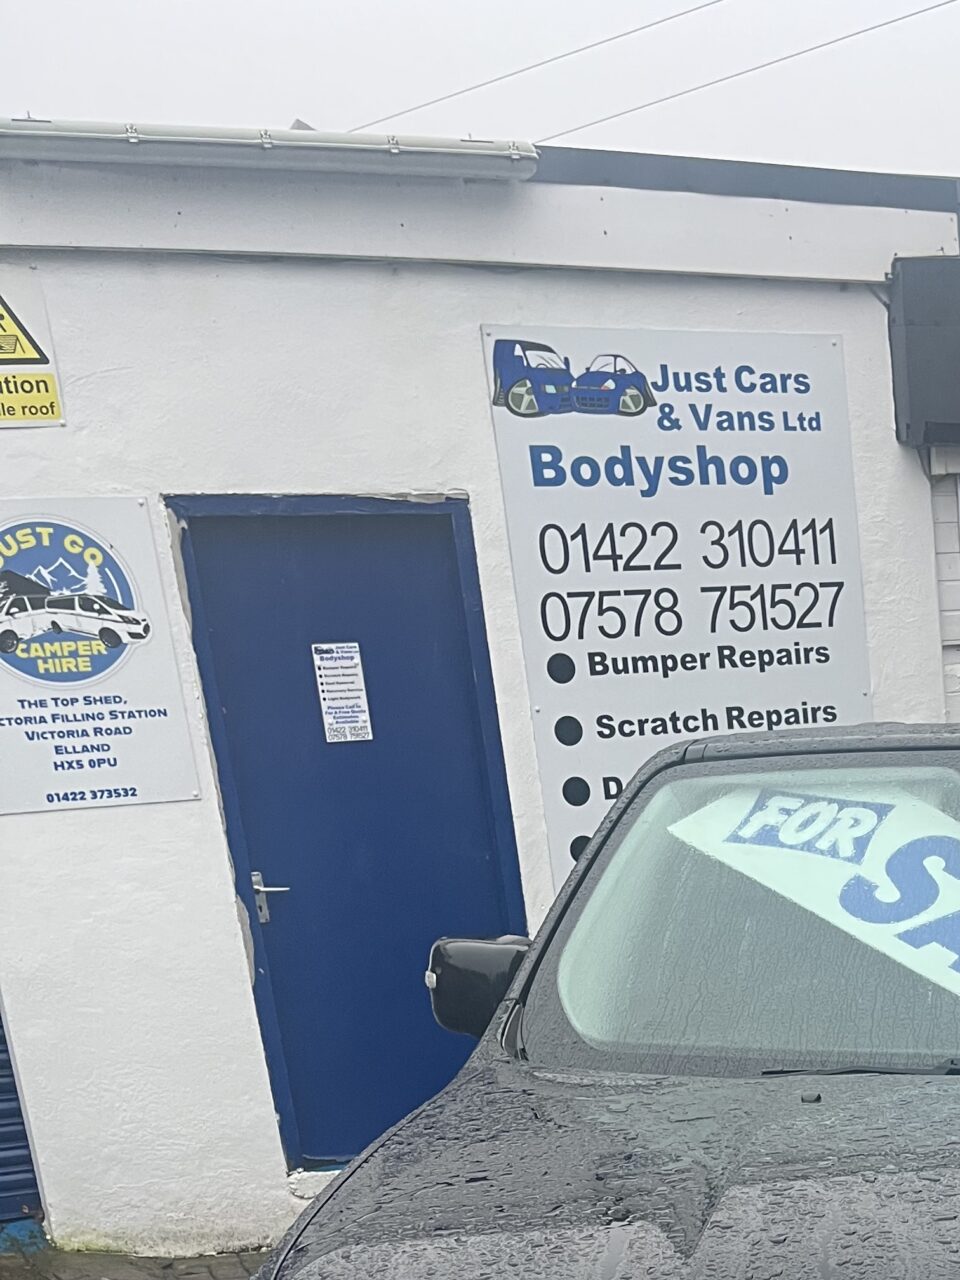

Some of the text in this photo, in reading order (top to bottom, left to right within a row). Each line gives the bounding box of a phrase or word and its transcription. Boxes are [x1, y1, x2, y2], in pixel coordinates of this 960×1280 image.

[0, 375, 49, 394] tion
[651, 364, 811, 394] Just Cars
[0, 401, 56, 416] le roof
[657, 403, 822, 432] & Vans Ltd
[528, 445, 789, 498] Bodyshop
[0, 527, 104, 569] UST GO
[538, 517, 837, 575] 01422 310411
[540, 581, 844, 642] 07578 751527
[16, 640, 108, 658] CAMPER
[37, 657, 92, 673] HIRE
[587, 641, 831, 678] Bumper Repairs
[17, 695, 128, 709] THE TOP SHED,
[51, 712, 105, 724] FILLING
[109, 708, 168, 720] STATION
[596, 701, 838, 739] Scratch Repairs
[25, 726, 133, 741] VICTORIA ROAD
[54, 743, 111, 755] ELLAND
[53, 759, 84, 771] HX5
[46, 787, 138, 803] 01422 373532
[738, 795, 878, 858] FOR
